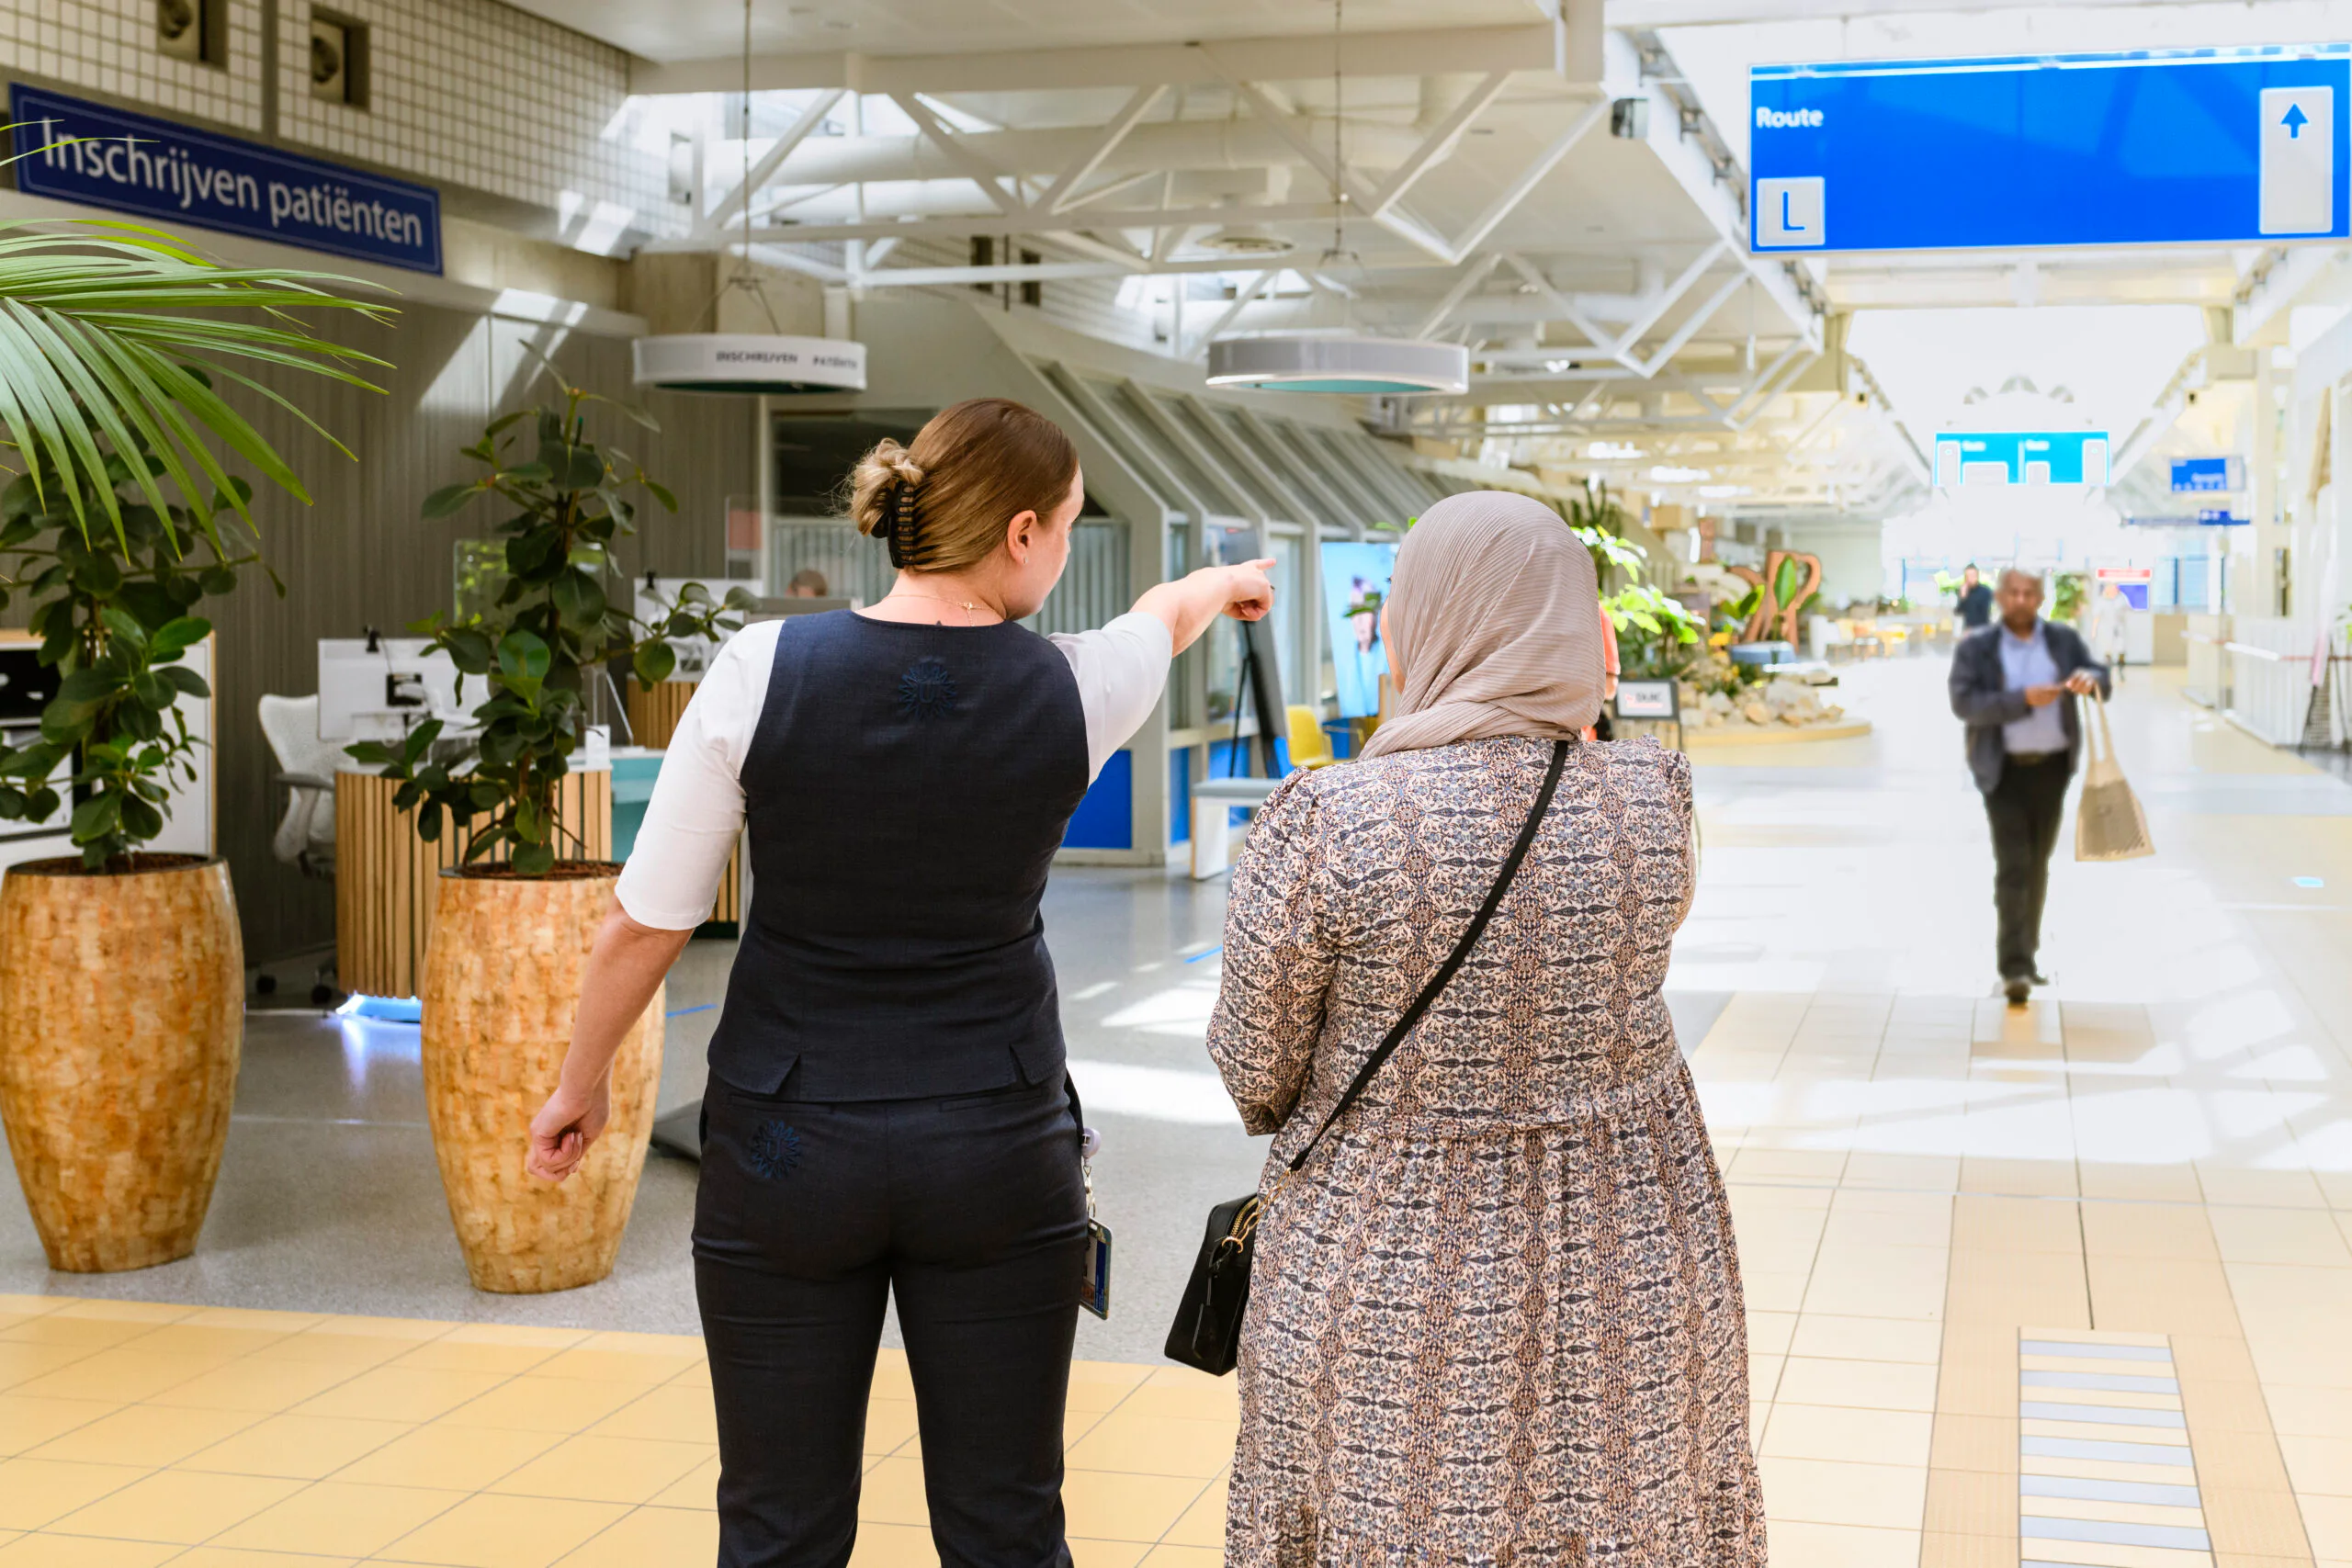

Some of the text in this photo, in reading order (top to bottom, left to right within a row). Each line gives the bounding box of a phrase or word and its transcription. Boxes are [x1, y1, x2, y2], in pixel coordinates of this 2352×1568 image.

[1756, 107, 1825, 128] Route
[42, 116, 423, 248] Inschrijven patiënten
[1782, 191, 1805, 231] L
